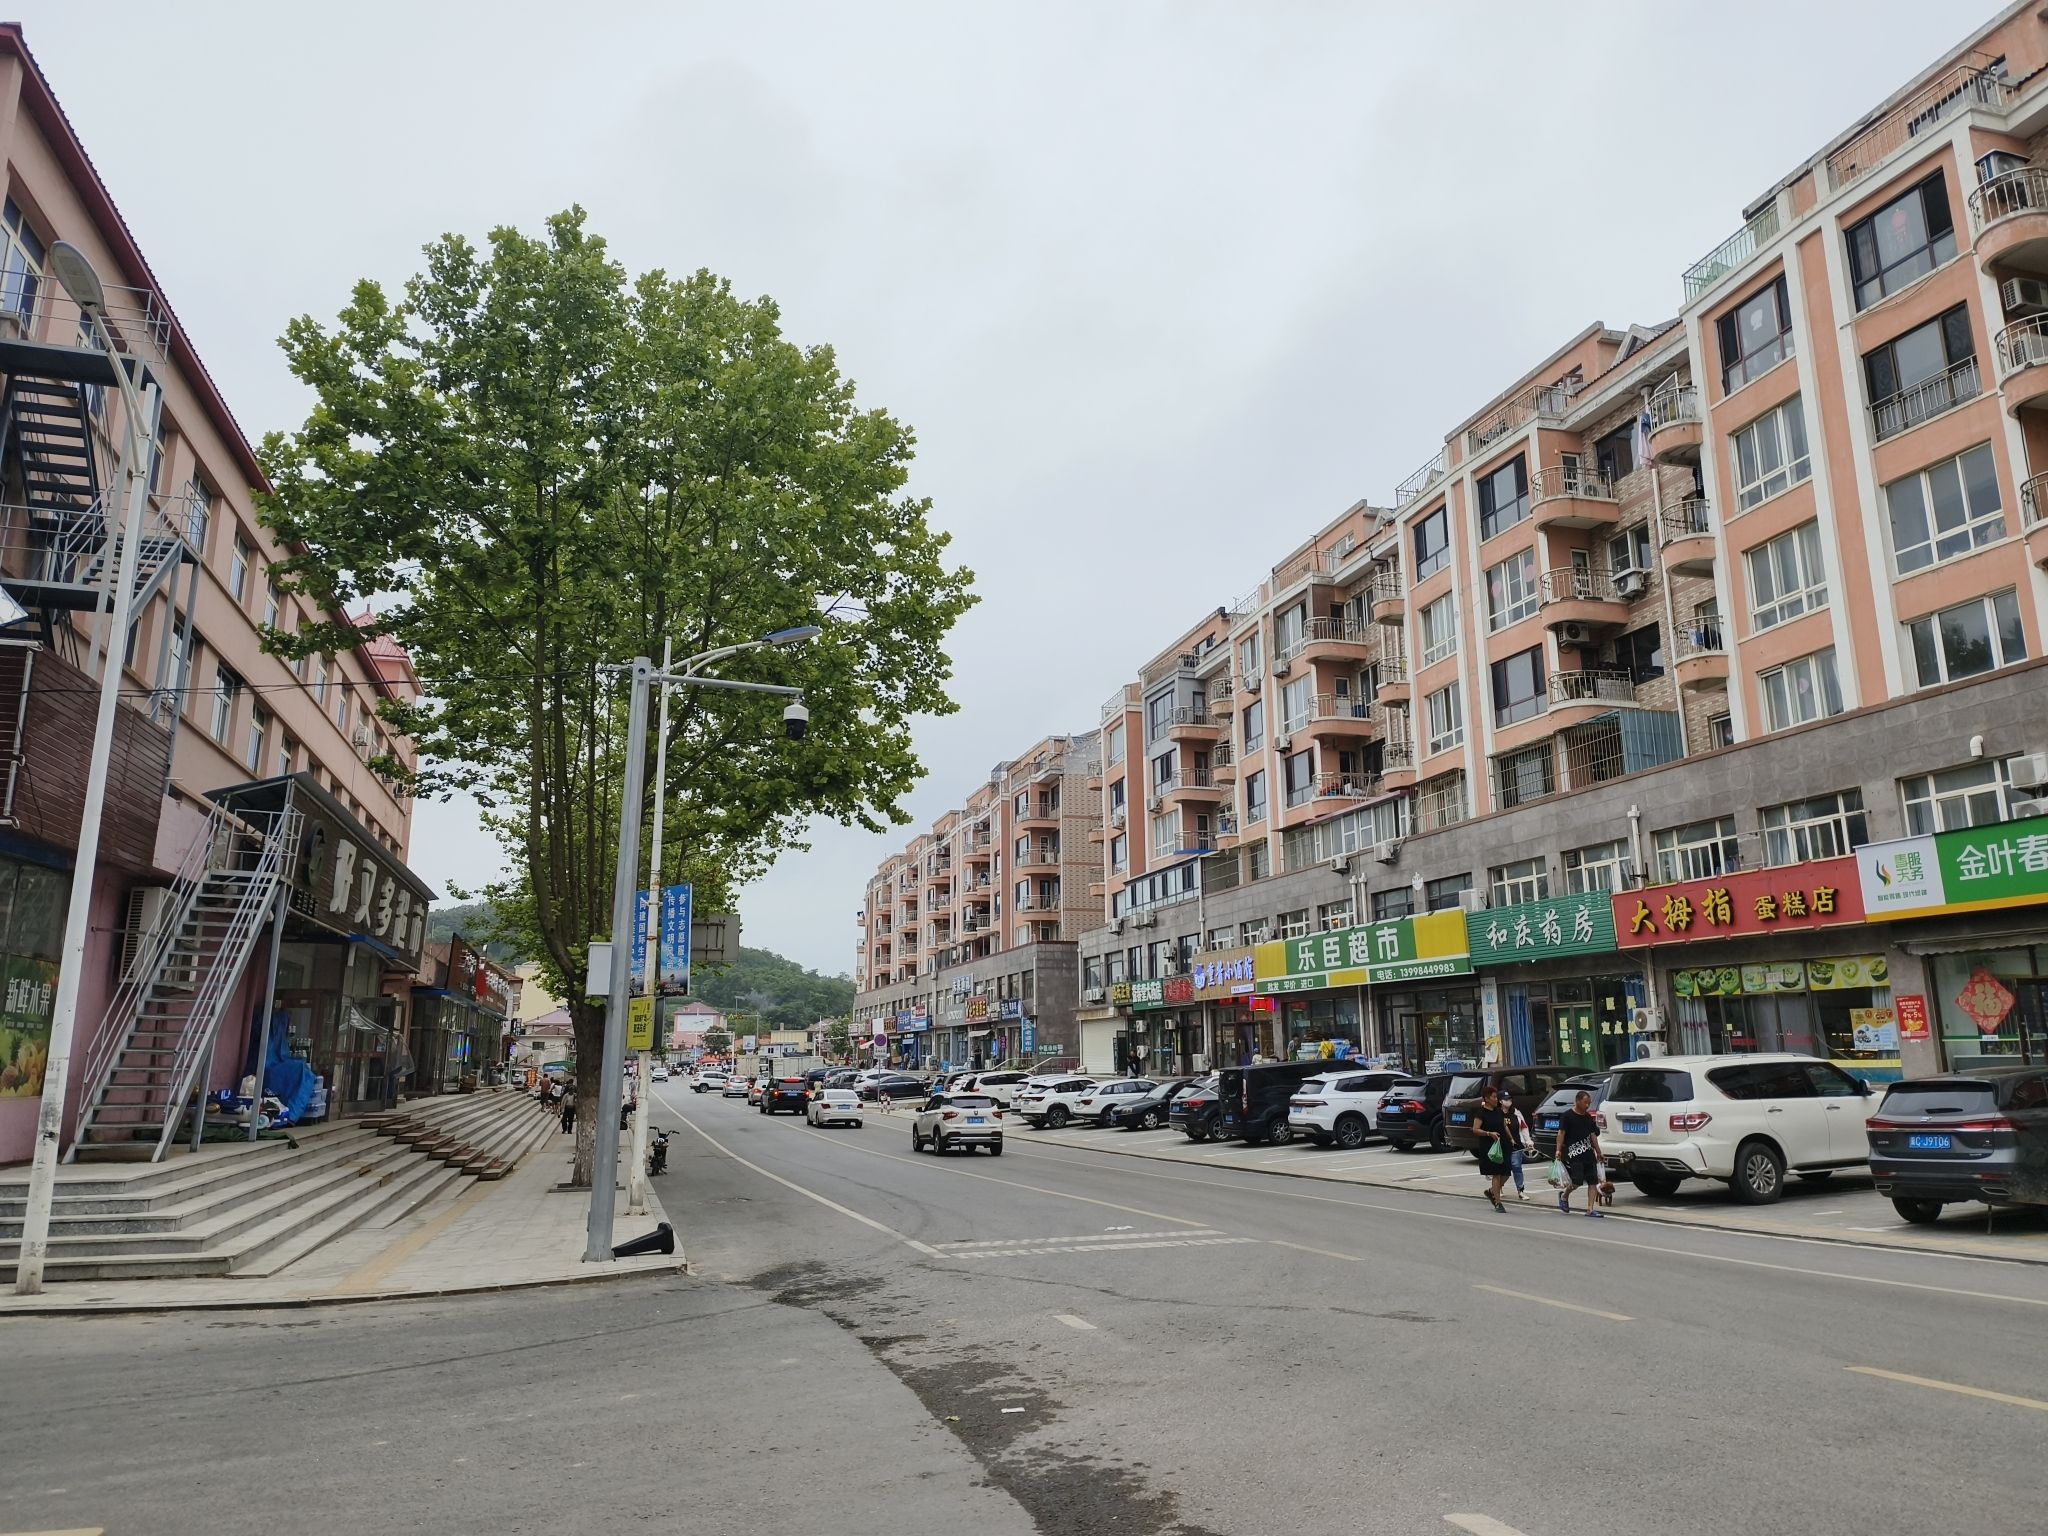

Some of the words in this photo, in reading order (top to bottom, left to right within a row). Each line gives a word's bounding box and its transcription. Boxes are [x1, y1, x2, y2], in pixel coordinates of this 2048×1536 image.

[330, 839, 424, 957] 好又多超市
[1630, 888, 1732, 933] 大拇指
[1753, 886, 1836, 920] 蛋糕店
[1298, 926, 1400, 971] 乐臣超市
[1486, 904, 1595, 951] 和庆药房
[5, 977, 51, 1016] 新鲜水果
[1300, 978, 1314, 989] 进口
